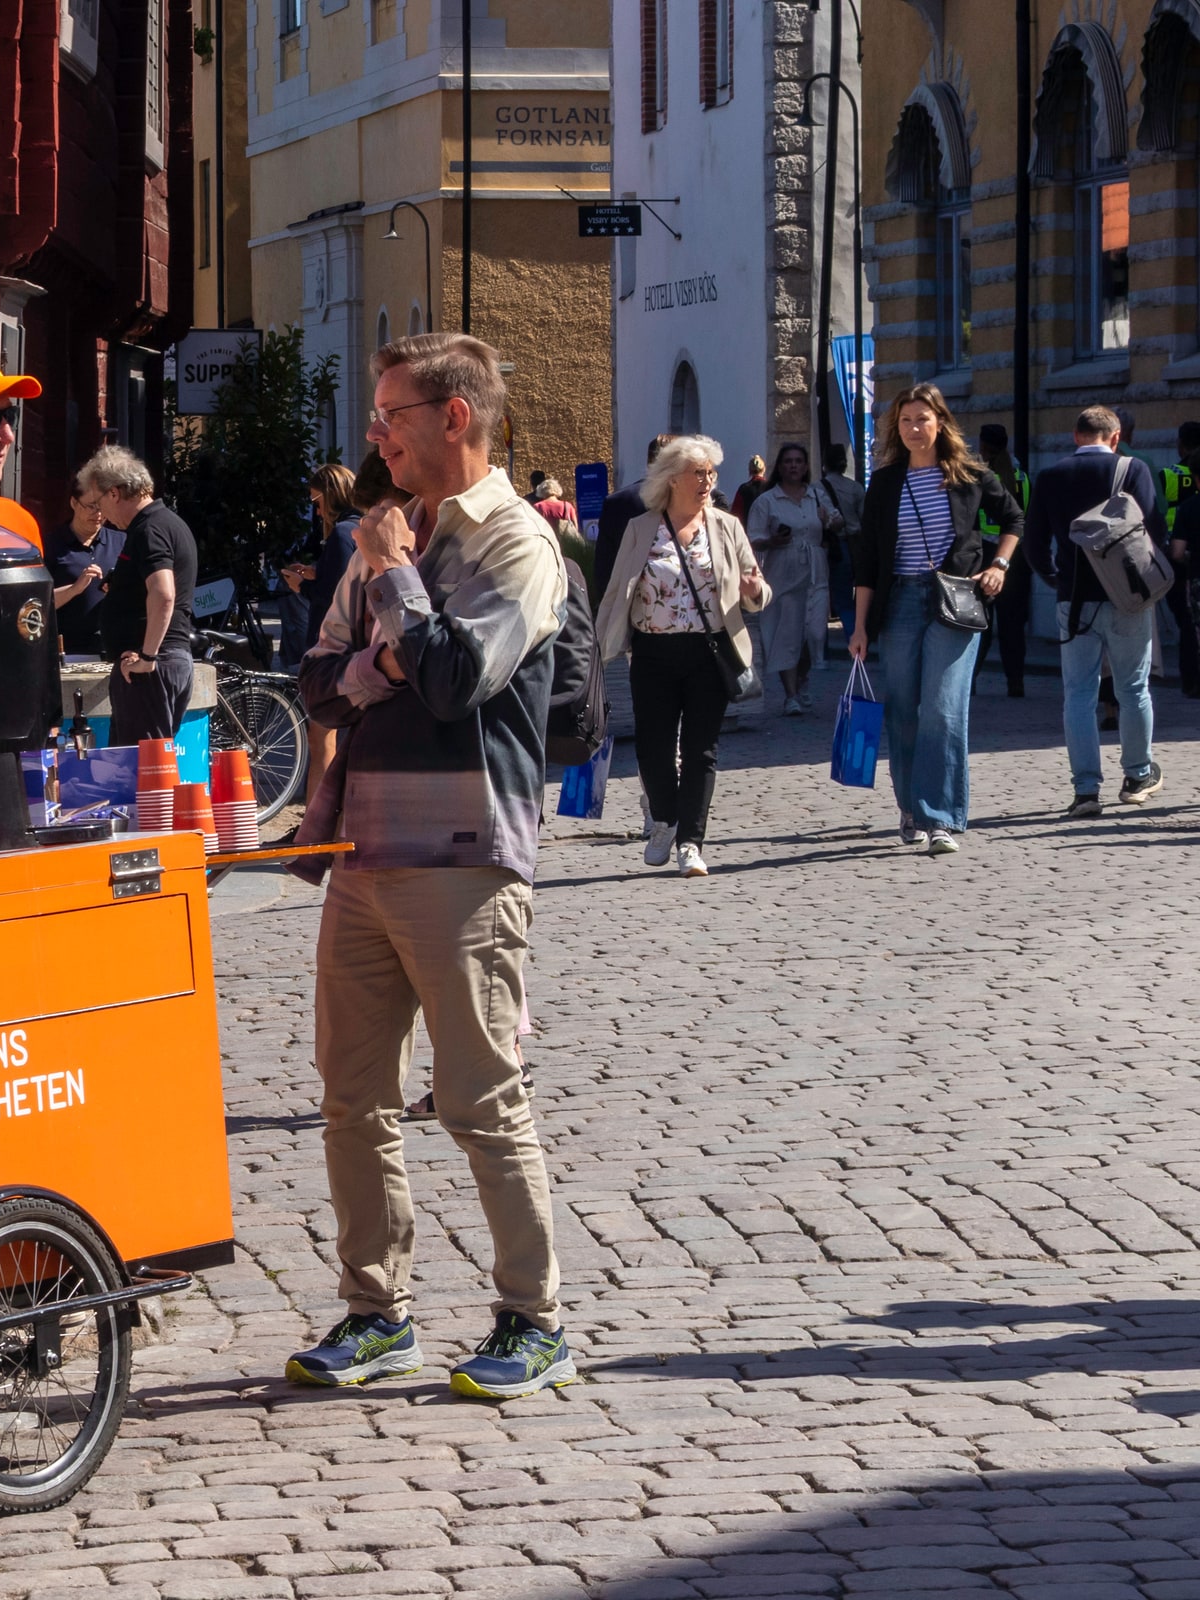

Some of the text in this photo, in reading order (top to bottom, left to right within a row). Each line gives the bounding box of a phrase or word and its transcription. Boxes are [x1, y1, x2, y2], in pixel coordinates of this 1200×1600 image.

[587, 216, 630, 224] VISBY BÖRS
[644, 271, 718, 312] HOTELL VISBY BÖRS
